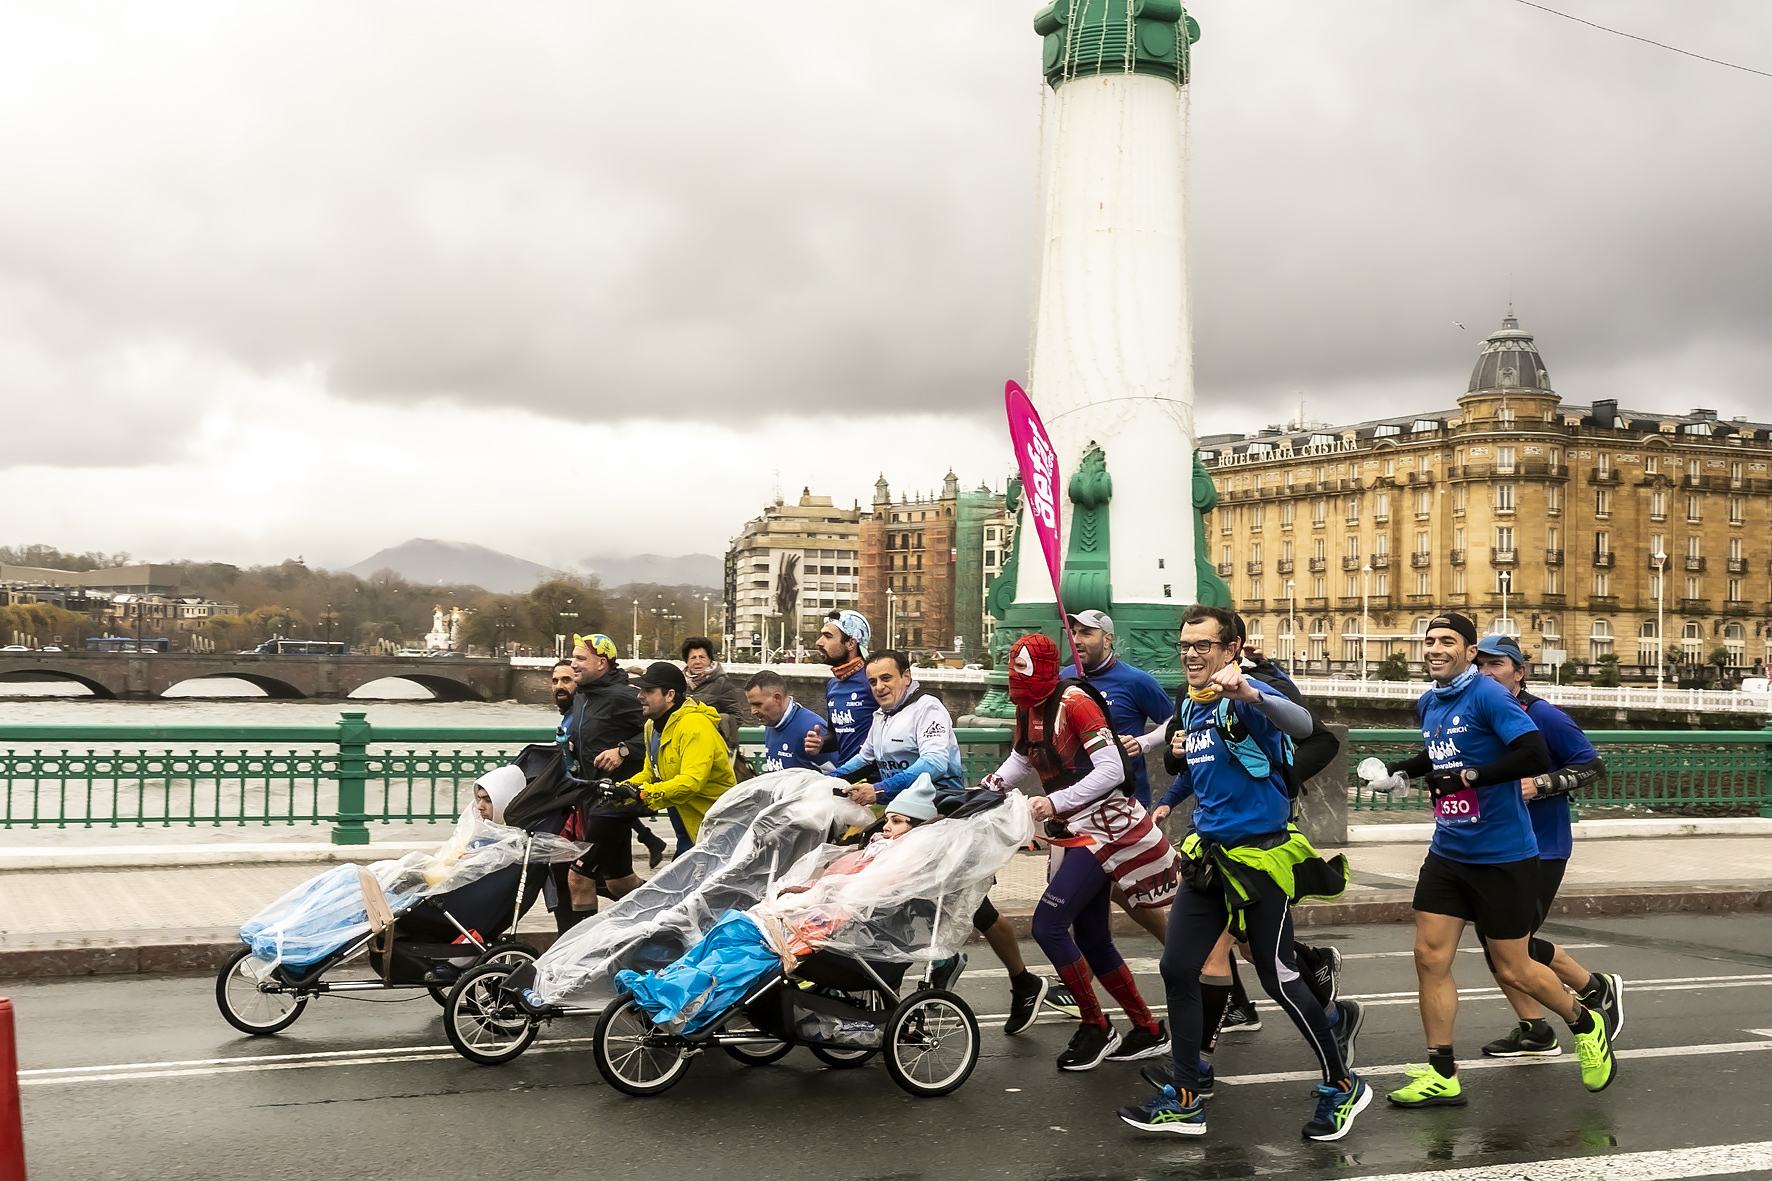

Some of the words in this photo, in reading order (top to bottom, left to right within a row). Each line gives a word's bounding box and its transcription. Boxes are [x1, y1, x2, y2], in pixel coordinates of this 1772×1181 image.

[1218, 452, 1252, 467] HOTEL
[1302, 439, 1358, 456] CRISTINA
[1446, 725, 1468, 735] ZURICH
[1577, 769, 1597, 780] TRAIL
